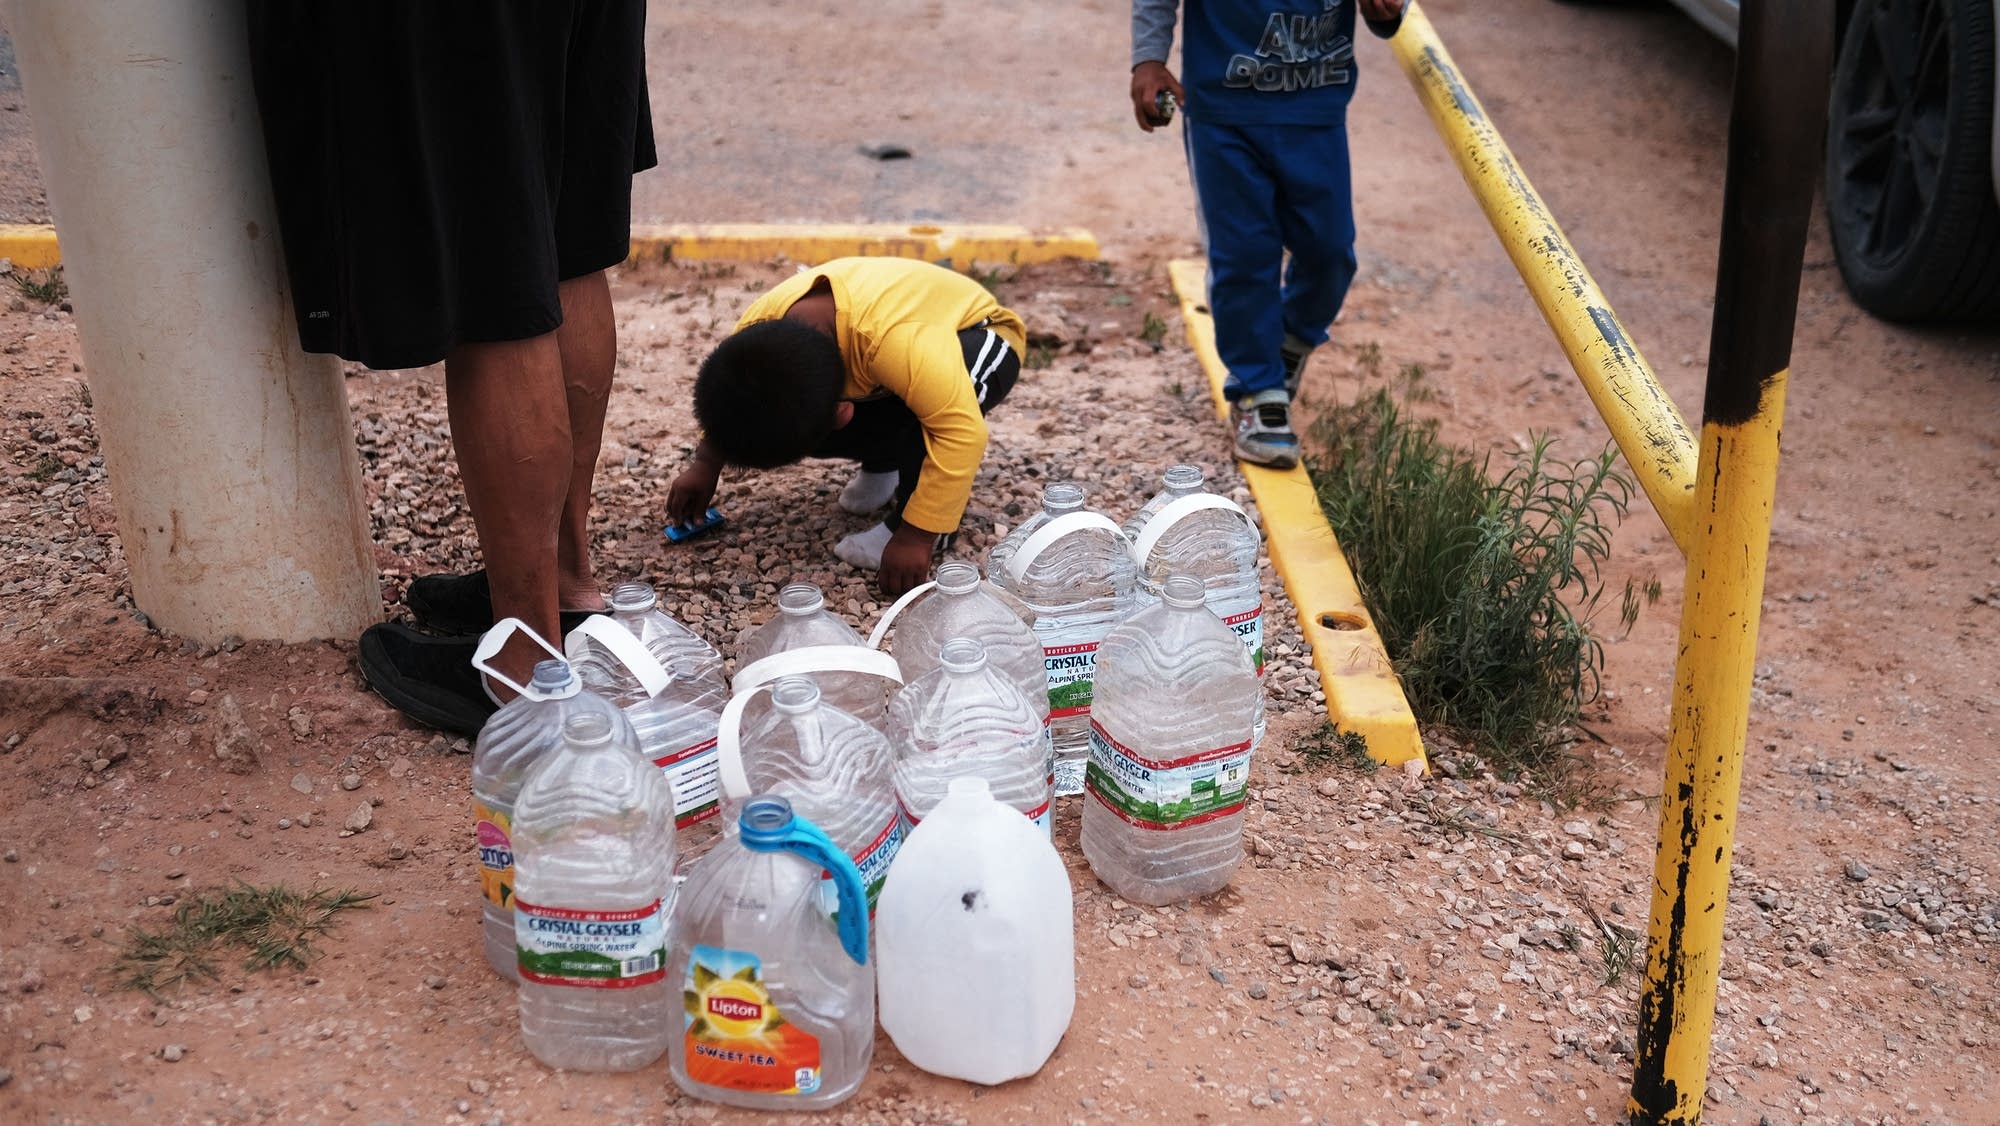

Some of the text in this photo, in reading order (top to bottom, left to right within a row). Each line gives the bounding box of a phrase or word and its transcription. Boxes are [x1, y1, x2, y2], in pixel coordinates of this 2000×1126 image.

[1047, 646, 1077, 655] BOTTLED
[1080, 644, 1088, 652] AT
[1044, 655, 1089, 671] CRYSTAL
[1067, 667, 1094, 675] NATU
[1048, 672, 1094, 684] ALPINE SPRI
[1114, 753, 1151, 782] GEYSER
[528, 918, 642, 937] CRYSTAL GEYSER
[535, 936, 568, 949] ALPINE
[605, 942, 638, 952] WATER
[556, 933, 617, 943] NATURAL
[711, 999, 759, 1018] Lipton
[696, 1044, 776, 1066] SWEET TEA
